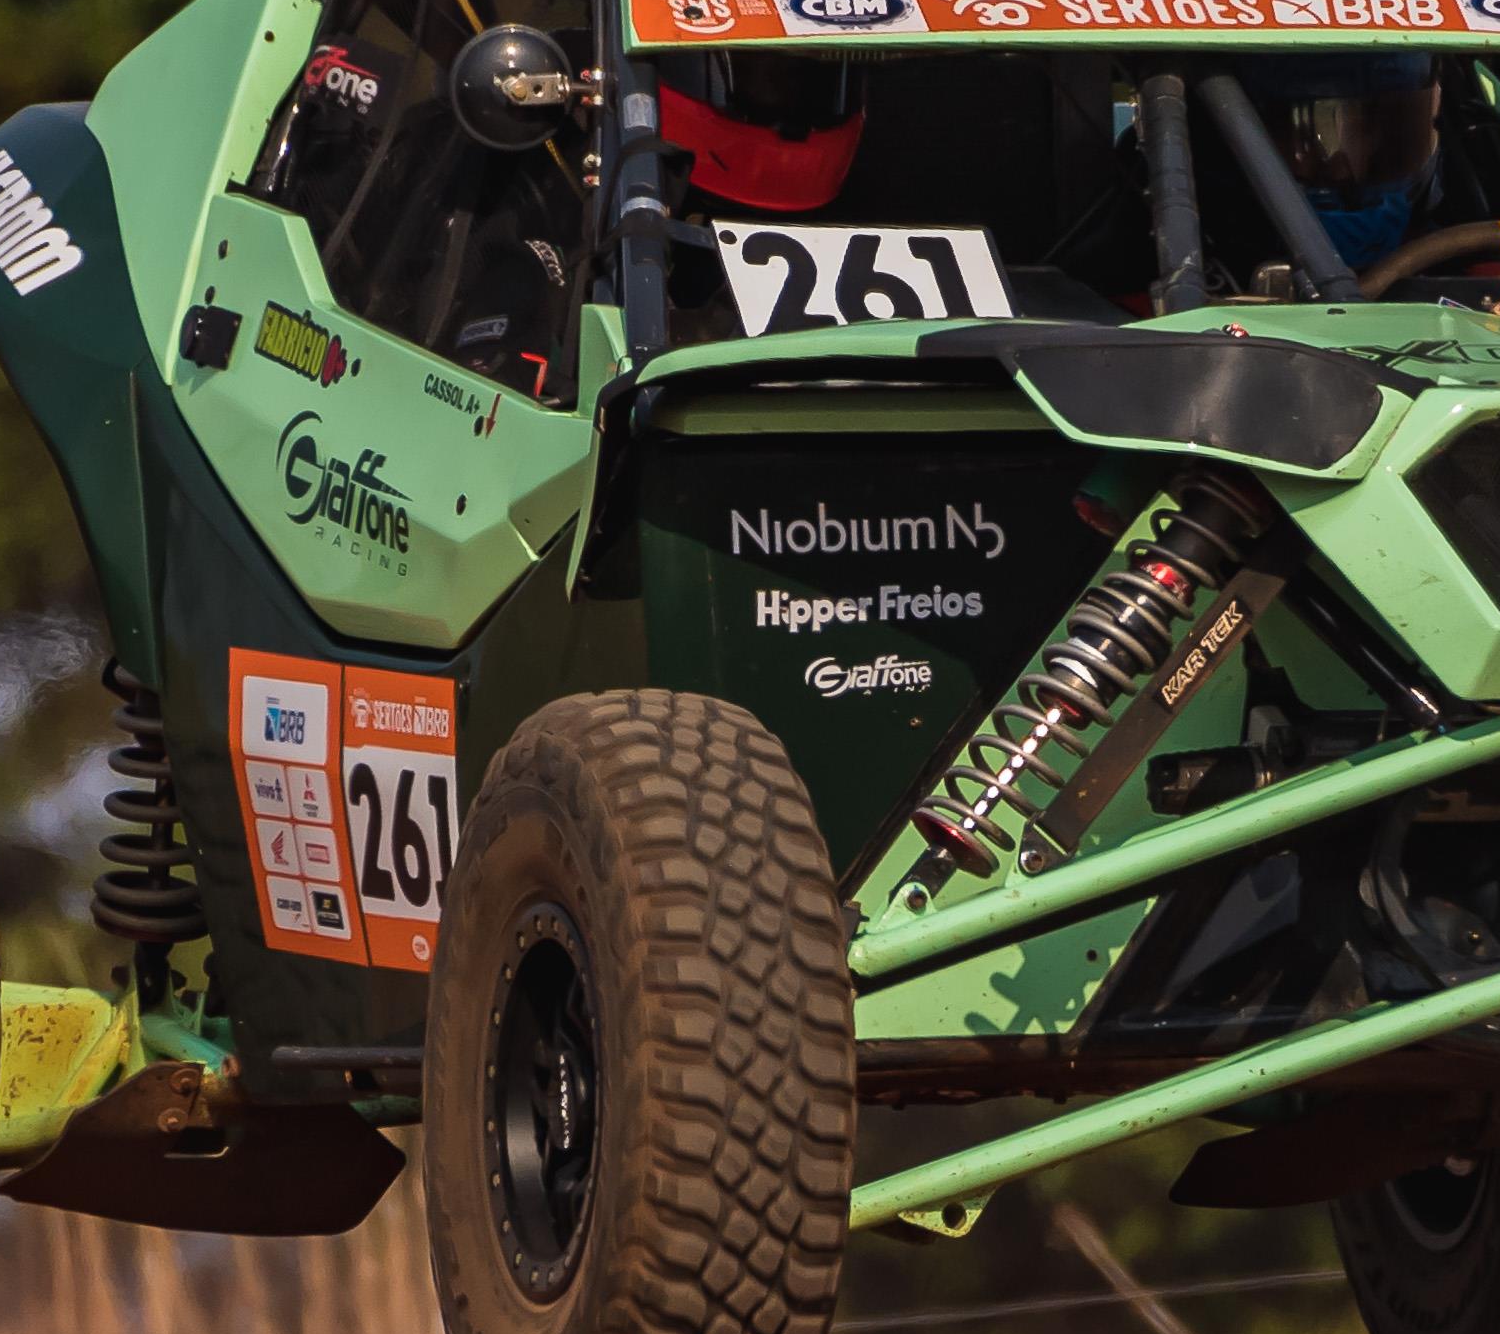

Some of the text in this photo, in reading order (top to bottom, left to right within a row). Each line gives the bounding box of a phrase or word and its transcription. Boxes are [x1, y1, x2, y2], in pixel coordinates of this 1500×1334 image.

[972, 1, 1030, 26] 30
[742, 231, 976, 334] 261
[424, 373, 463, 412] CASSOL
[314, 526, 408, 577] RACING
[731, 503, 936, 555] Niobium
[756, 585, 984, 633] Hipper Freios
[1161, 600, 1244, 705] KAR TEK
[279, 709, 305, 745] BRB
[350, 762, 453, 908] 261
